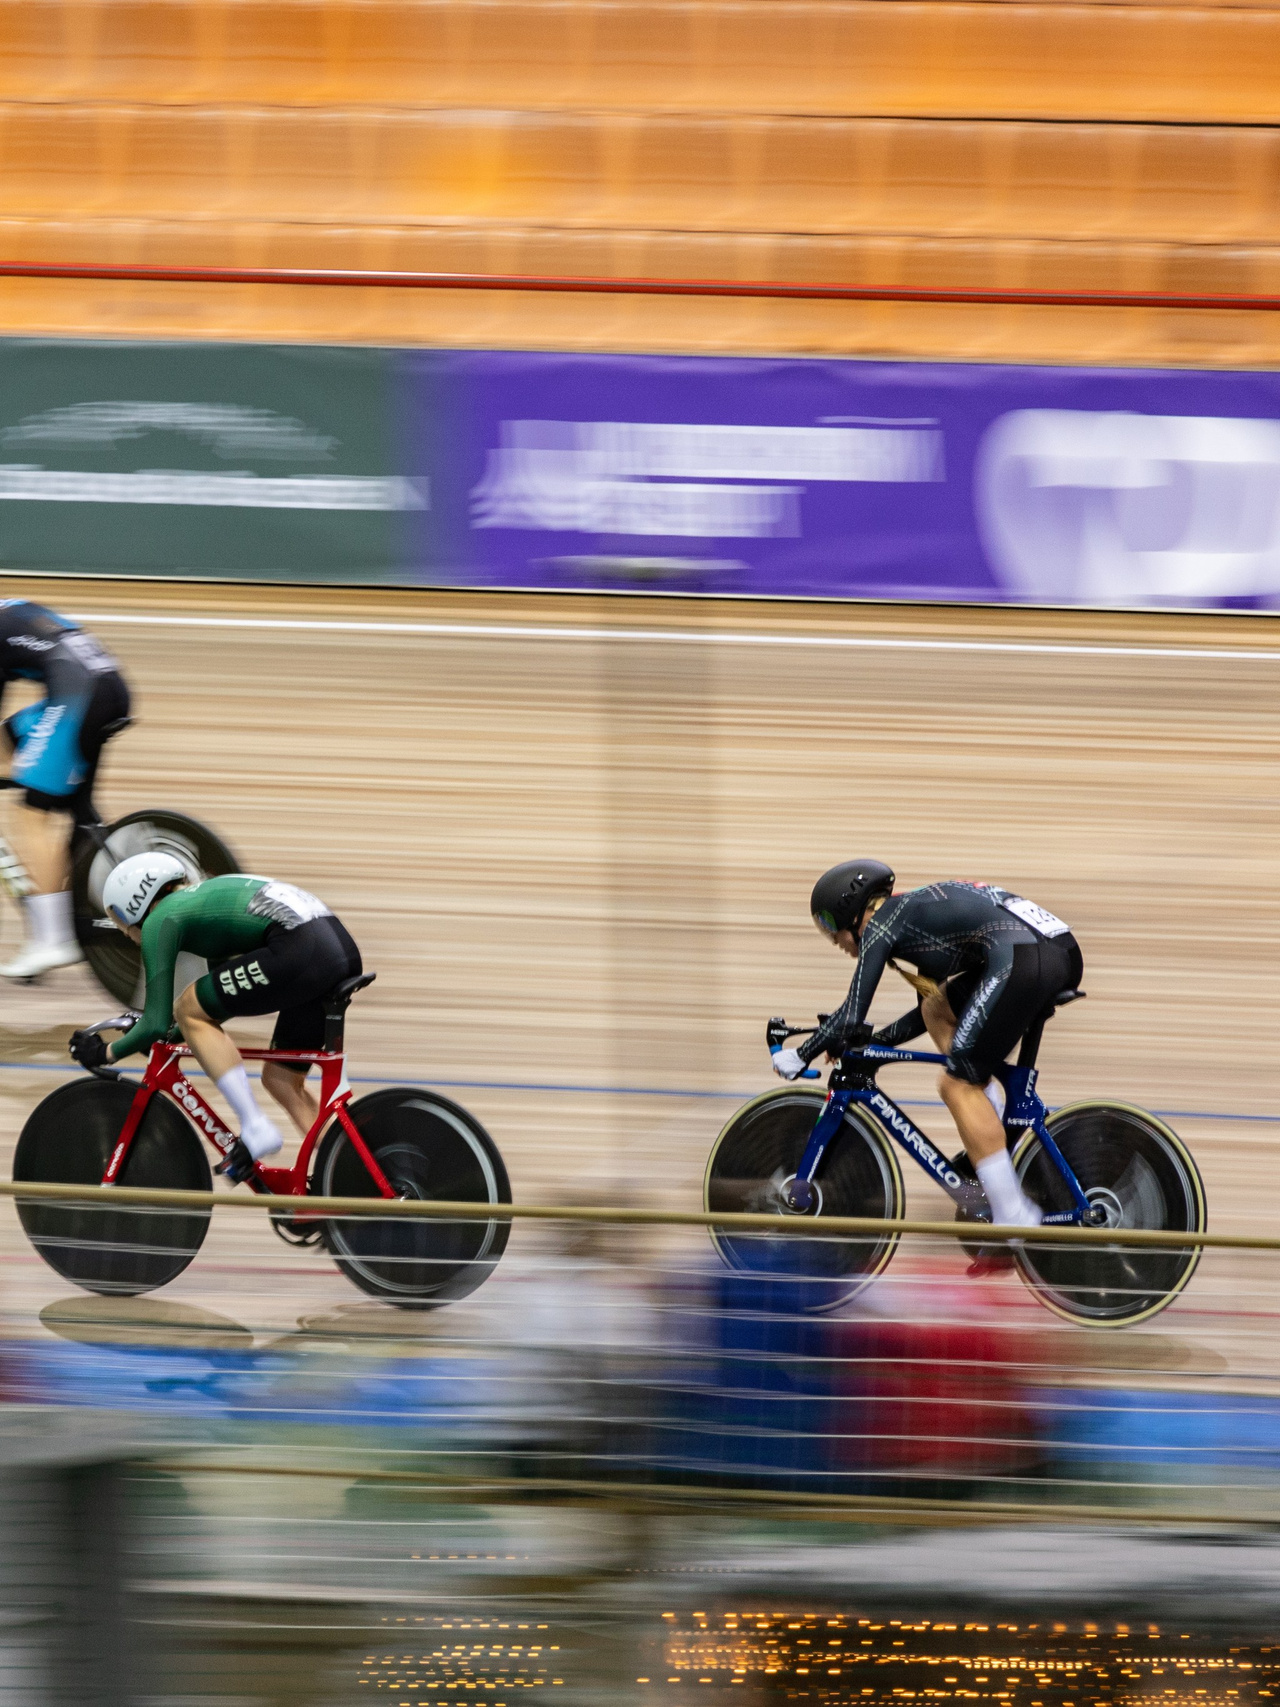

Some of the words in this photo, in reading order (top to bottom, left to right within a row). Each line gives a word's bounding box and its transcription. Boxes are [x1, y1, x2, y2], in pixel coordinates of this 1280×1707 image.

[125, 872, 157, 917] KASK
[219, 969, 238, 996] UP
[234, 965, 253, 991] UP
[247, 960, 270, 986] UP
[863, 1048, 913, 1061] PINARELLO
[870, 1093, 961, 1189] PINARELLO
